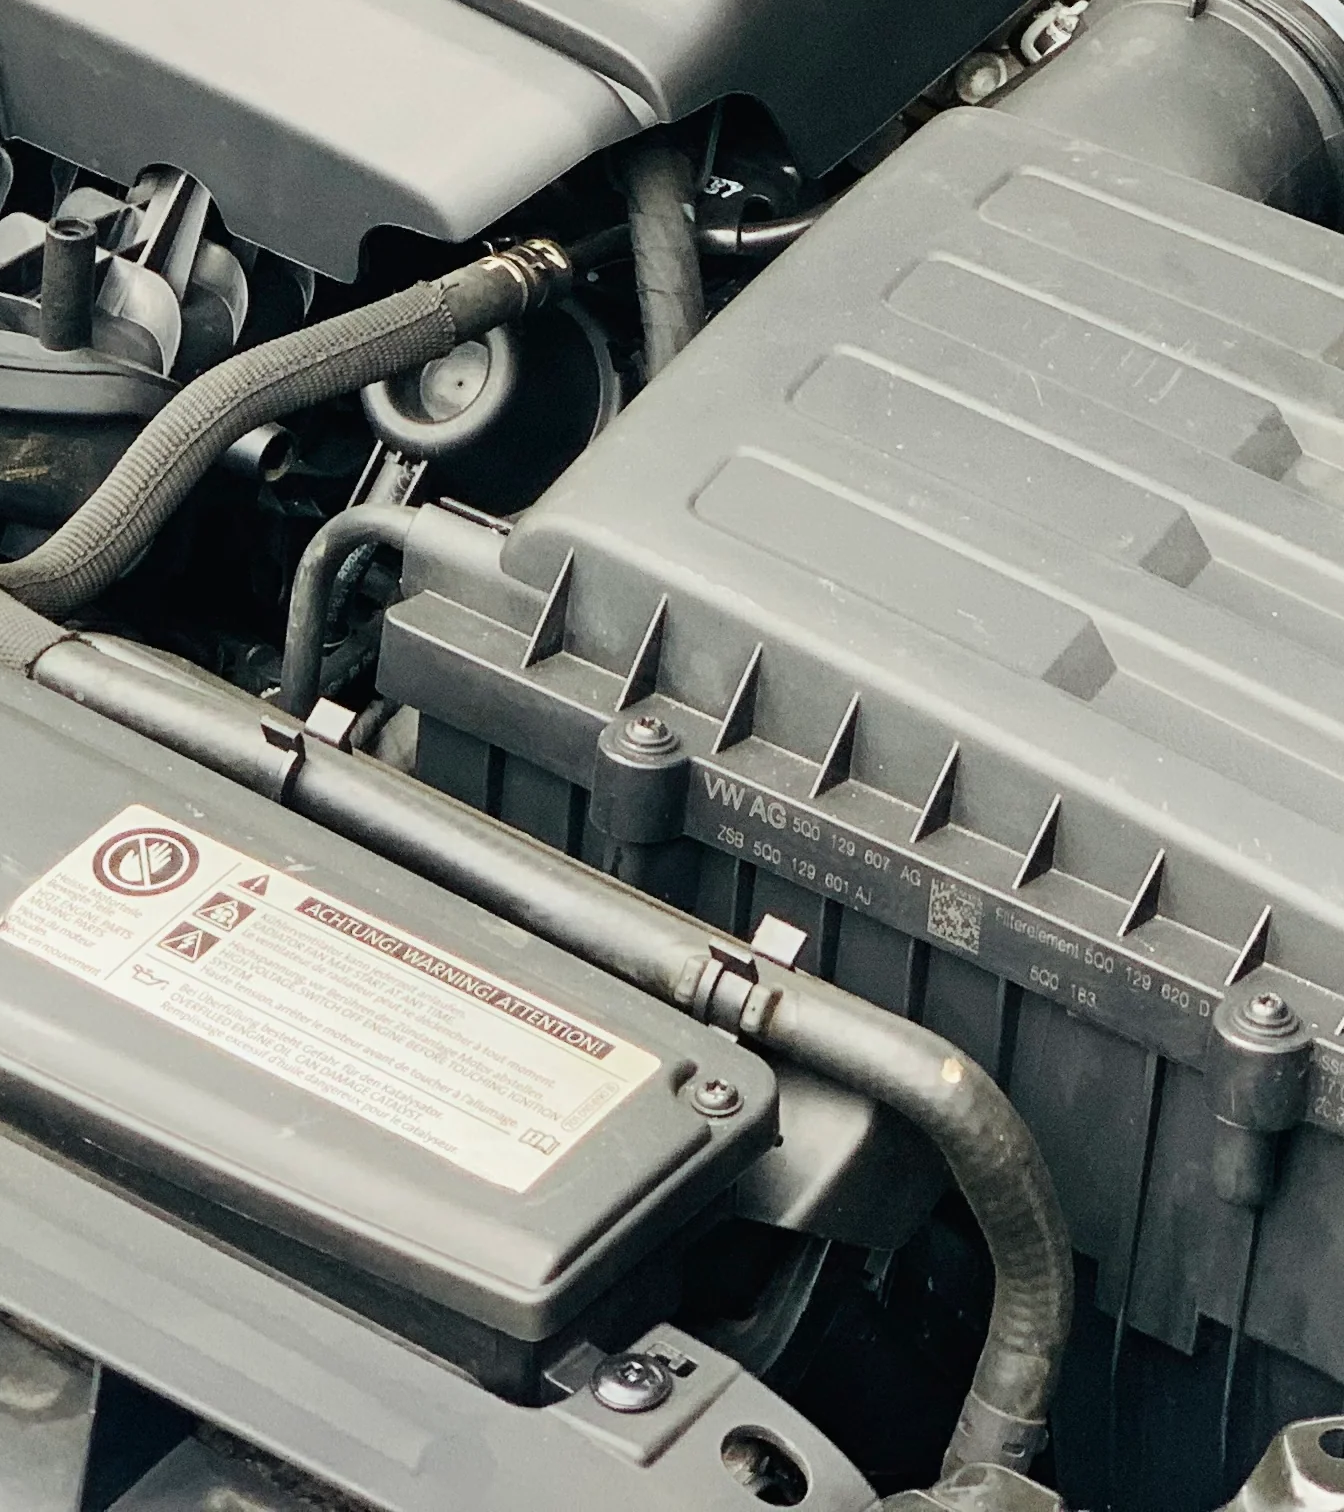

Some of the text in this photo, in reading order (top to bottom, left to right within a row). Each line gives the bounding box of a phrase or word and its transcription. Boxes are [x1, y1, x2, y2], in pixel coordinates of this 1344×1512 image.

[704, 771, 922, 887] VW AG 5Q0 129 607 AG
[716, 823, 872, 906] ZSB 5Q0 129 601 AJ
[30, 895, 106, 937] MOVING PARTS
[37, 888, 133, 939] HOT ENGINE PARTS
[994, 905, 1211, 1018] Filterelement 5Q0 129 620 D
[252, 922, 305, 950] RADIATOR
[303, 945, 328, 961] FAN
[327, 956, 352, 973] MAY
[352, 970, 386, 989] START
[383, 985, 403, 999] AT
[400, 994, 424, 1009] ANY
[305, 903, 604, 1053] ACHTUNG! WARNING! ATTENTION!
[310, 961, 329, 975] de
[327, 971, 374, 997] radiateur
[481, 1046, 507, 1063] tout
[169, 992, 232, 1026] OVERFILLED
[230, 1022, 271, 1047] ENGINE
[272, 1043, 291, 1057] OIL
[294, 1054, 320, 1070] CAN
[318, 1066, 370, 1095] DAMAGE
[178, 983, 196, 995] Bei
[260, 1022, 302, 1048] besteht
[301, 1044, 340, 1066] Gefahr
[358, 1074, 381, 1087] den
[200, 964, 233, 984] Haute
[322, 1026, 363, 1048] moteur
[362, 1046, 395, 1065] avant
[393, 1062, 409, 1071] de
[409, 1068, 453, 1093] toucher
[220, 949, 249, 966] HIGH
[298, 987, 341, 1012] SWITCH
[340, 1008, 363, 1021] OFF
[361, 1018, 403, 1043] ENGINE
[405, 1040, 446, 1064] BEFORE
[448, 1060, 505, 1095] TOUCHING
[507, 1091, 561, 1121] IGNITION
[457, 1052, 492, 1074] Motor
[224, 1034, 270, 1058] excessif
[304, 1073, 361, 1104] dangereux
[360, 1102, 389, 1118] pour
[387, 1113, 405, 1126] le
